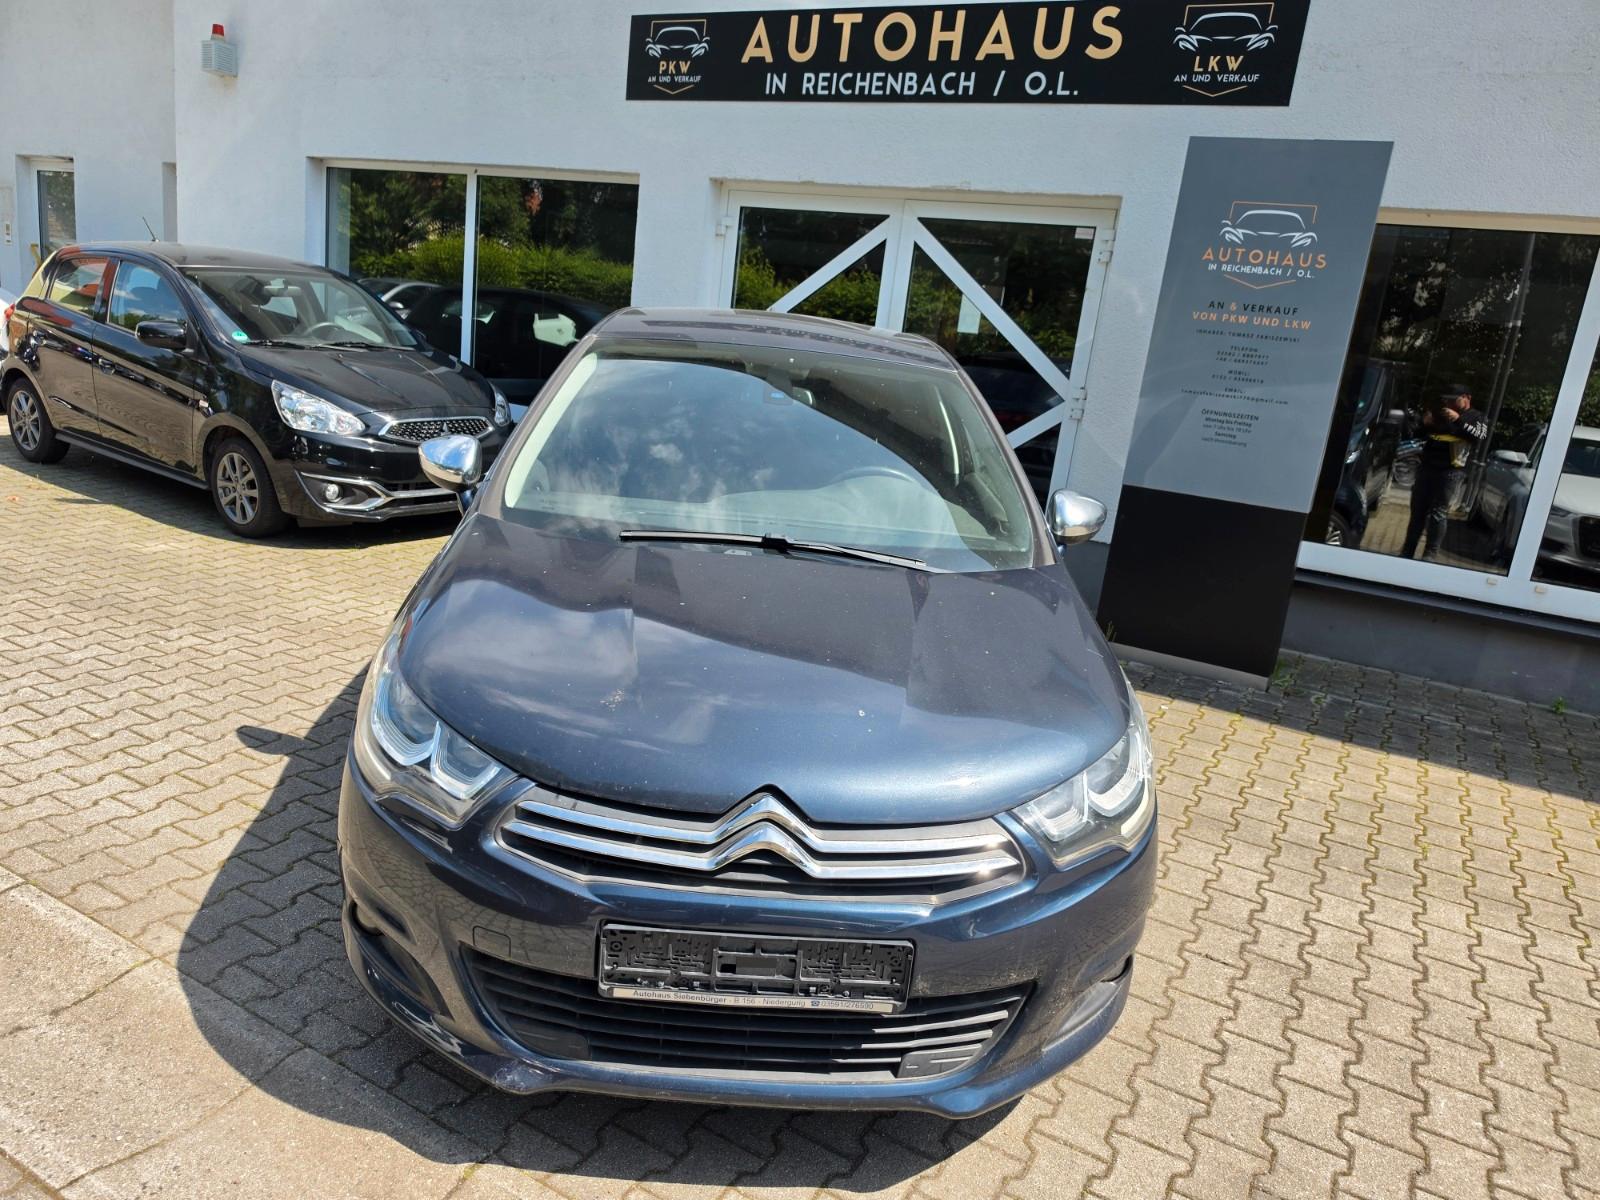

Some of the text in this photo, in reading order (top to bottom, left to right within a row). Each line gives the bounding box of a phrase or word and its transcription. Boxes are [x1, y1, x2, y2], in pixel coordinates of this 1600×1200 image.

[741, 5, 1124, 64] AUTOHAUS
[659, 60, 691, 74] PKW
[1193, 54, 1245, 72] LKW
[647, 75, 702, 83] AN UND VERKAUF
[765, 70, 1080, 97] IN REICHENBACH / O.L.
[1173, 73, 1261, 83] AN UND VERKAUF
[1201, 245, 1328, 269] AUTOHAUS
[1207, 263, 1315, 279] IN REICHENBACH / O.L.
[1208, 300, 1225, 310] AN
[1242, 303, 1299, 316] VERKAUF
[1192, 311, 1312, 330] VON PKW UND LKW
[1201, 408, 1260, 421] ÖFFNUNGSZEITEN
[633, 989, 671, 999] Autohaus
[673, 991, 727, 1006] Siebenbürger
